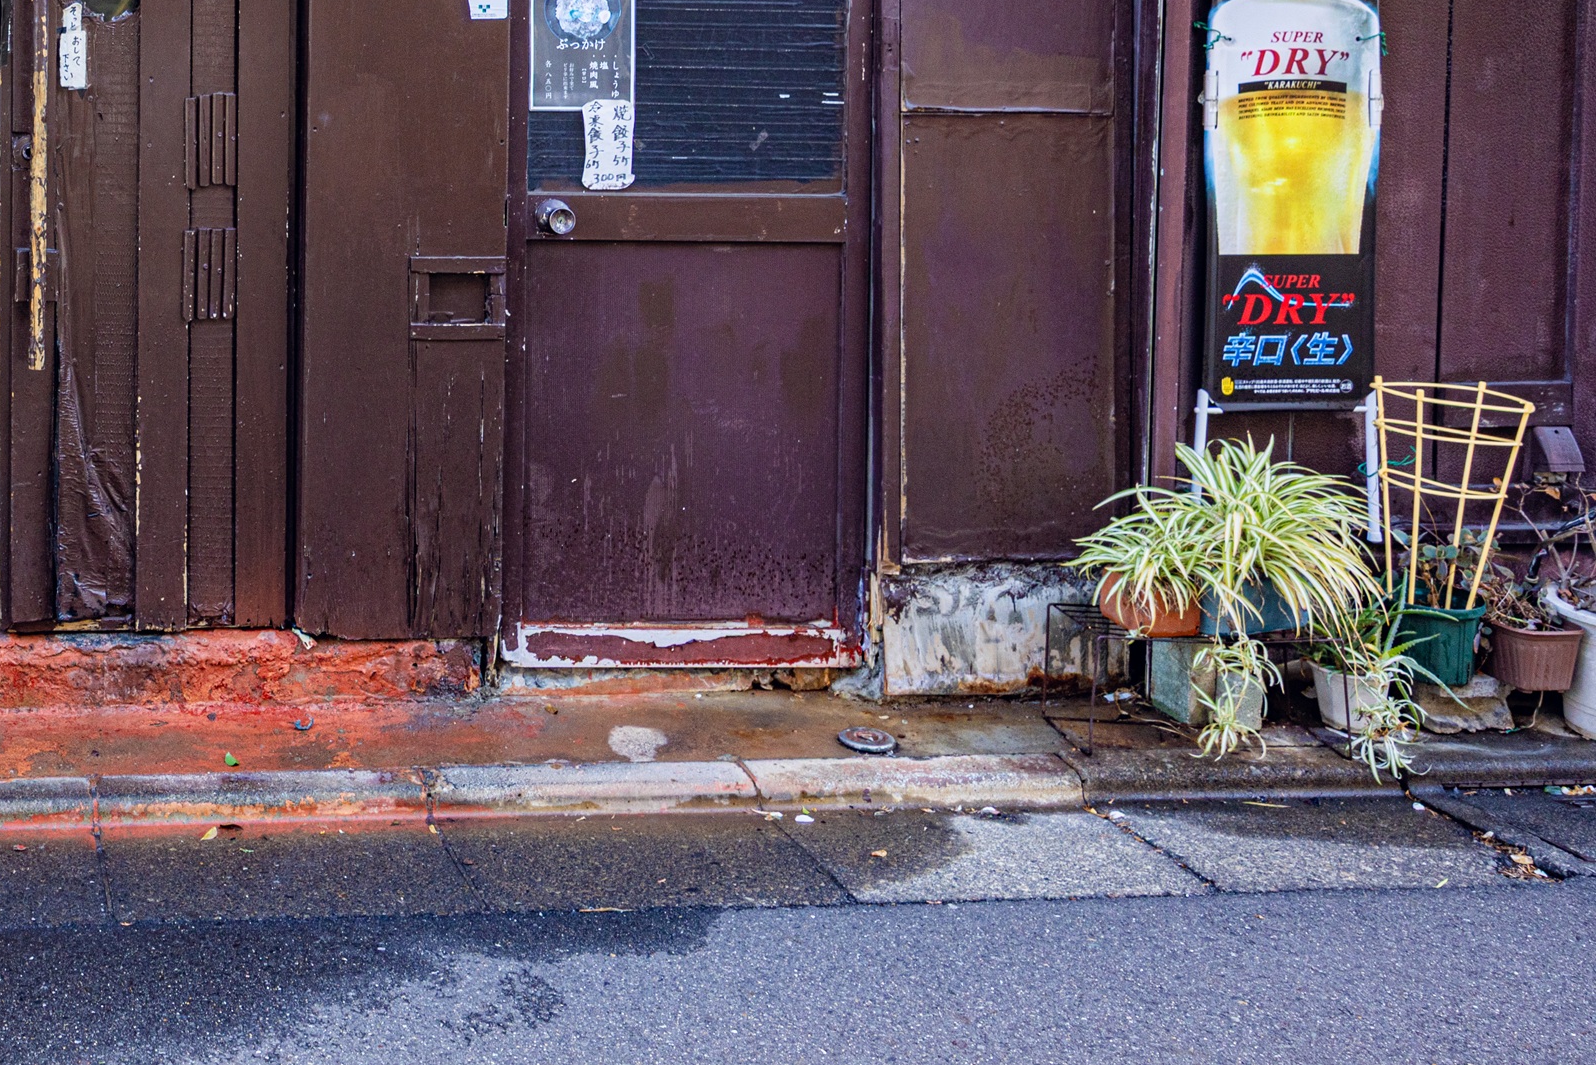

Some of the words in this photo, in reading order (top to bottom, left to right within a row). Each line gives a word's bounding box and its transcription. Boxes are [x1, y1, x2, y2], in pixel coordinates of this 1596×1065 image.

[1270, 30, 1324, 43] SUPER
[556, 38, 606, 51] ぶっかけ
[1259, 274, 1321, 289] SUPER
